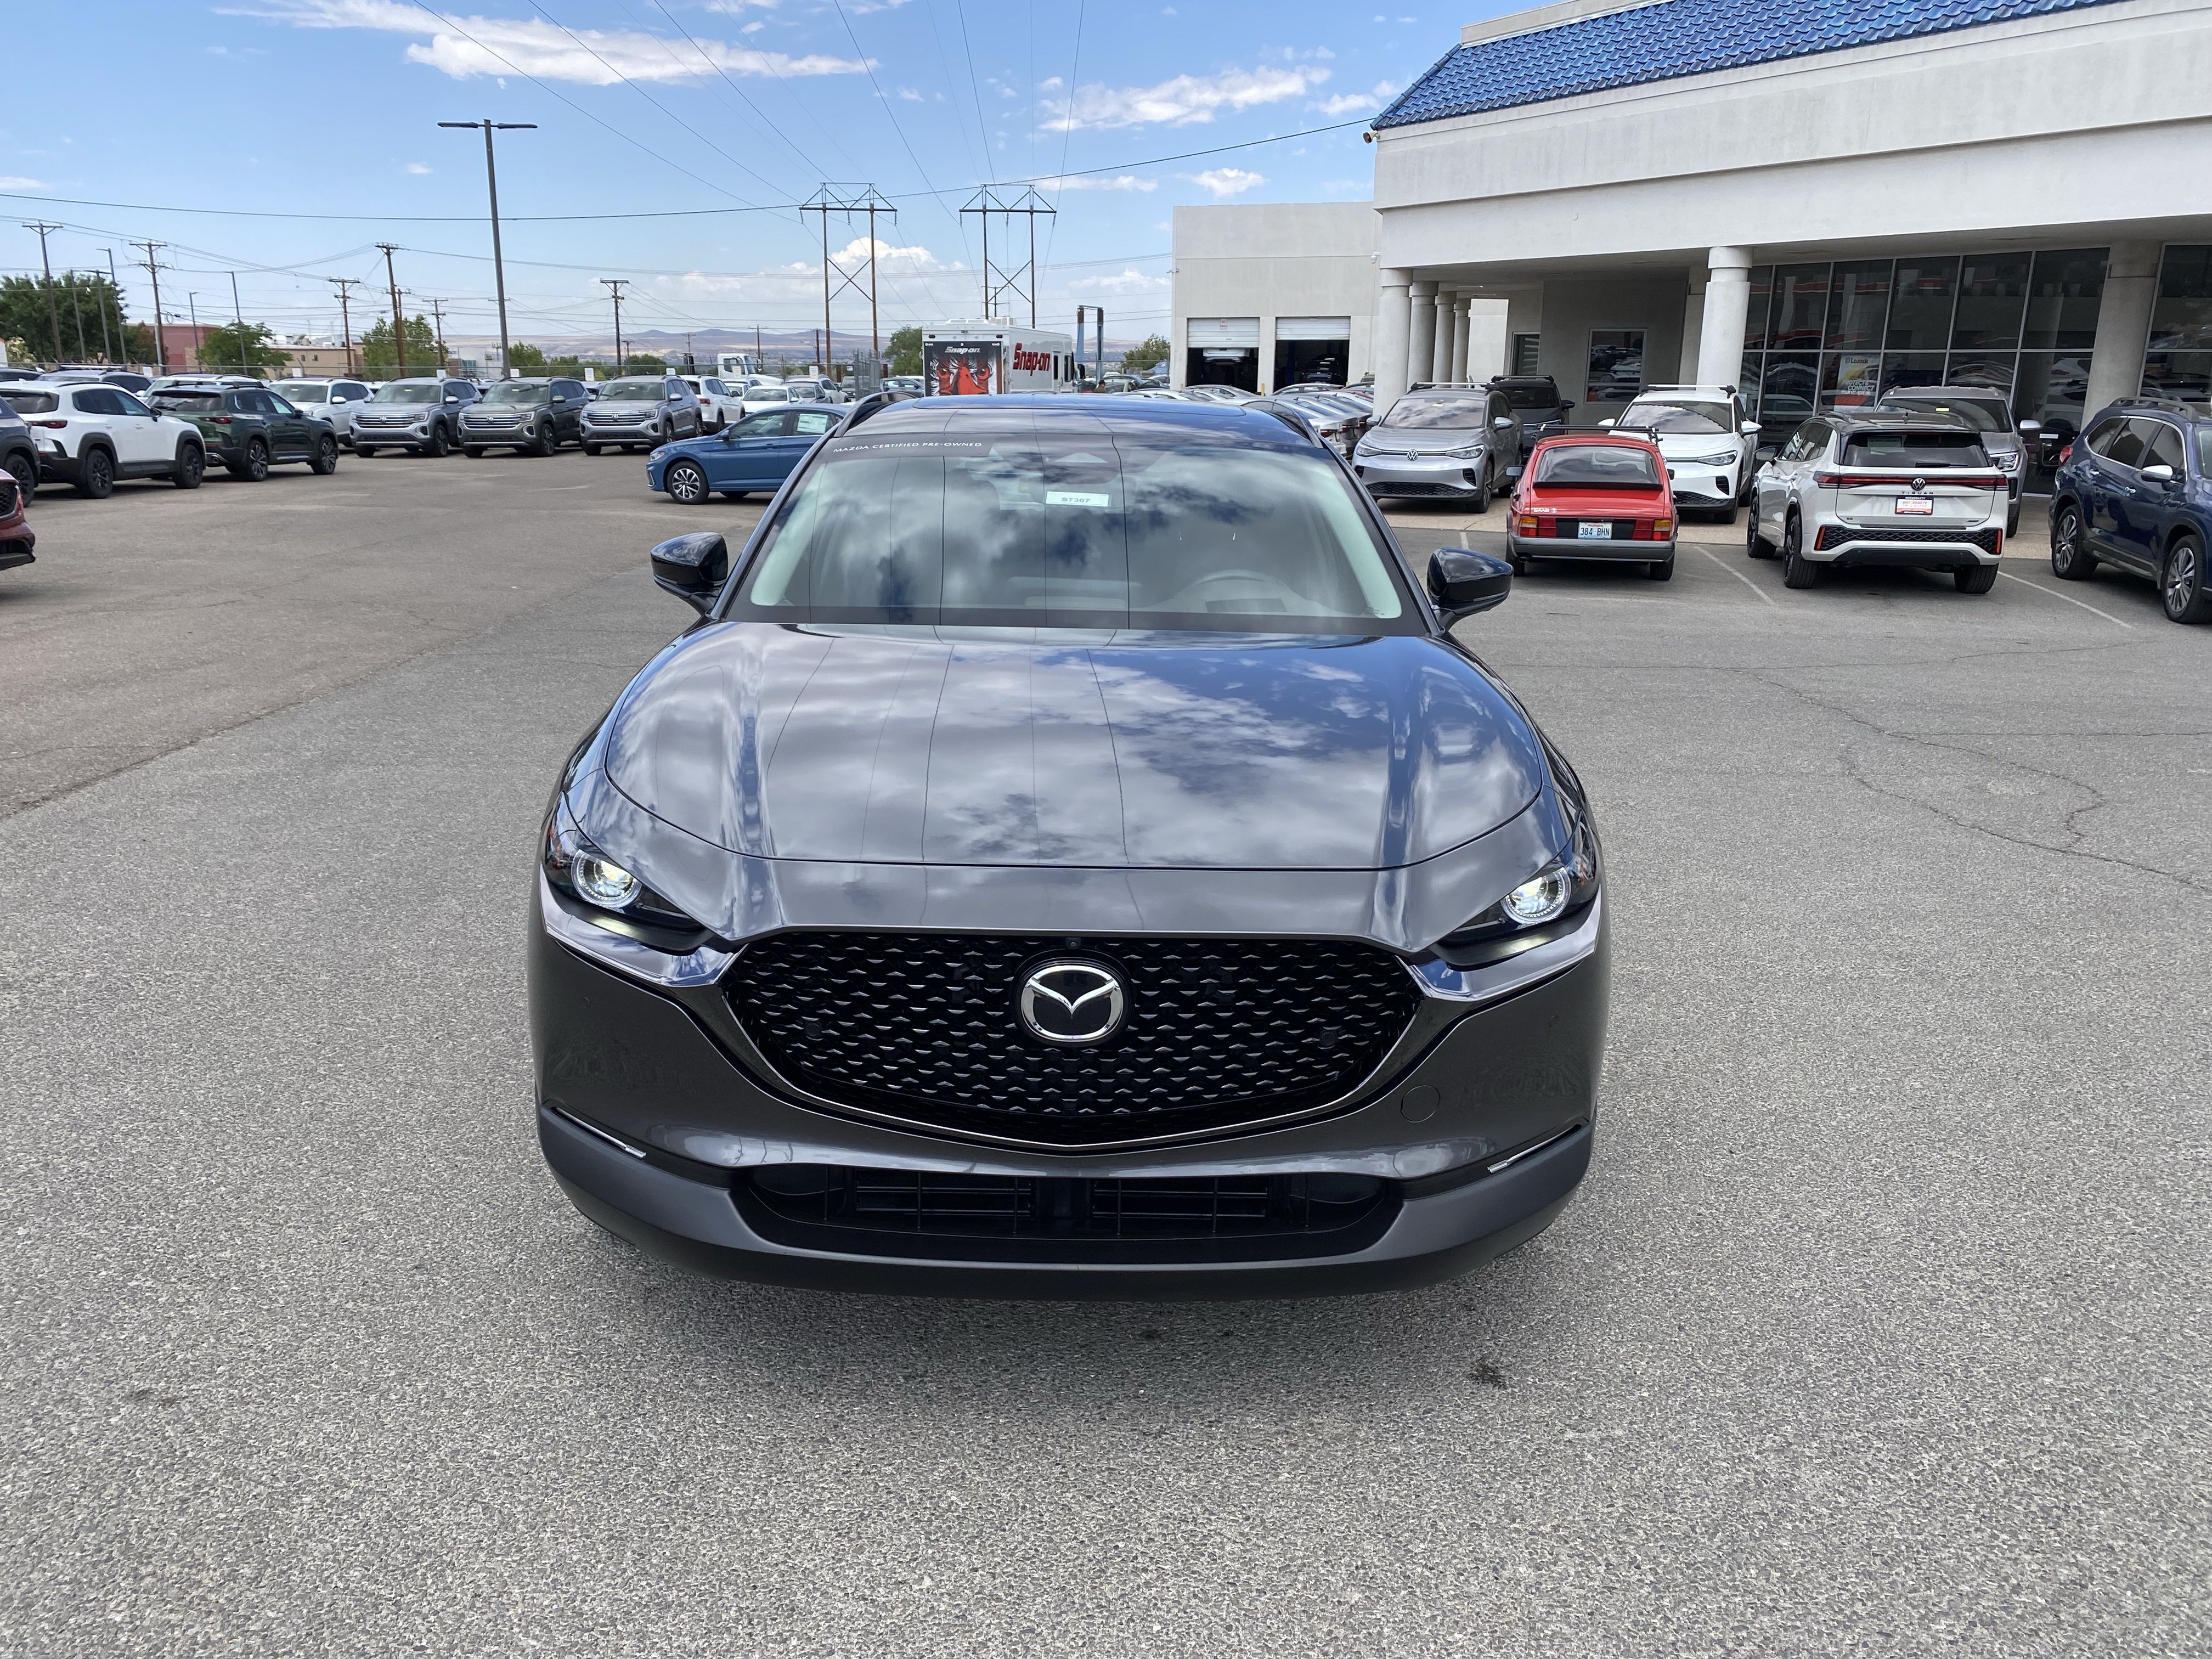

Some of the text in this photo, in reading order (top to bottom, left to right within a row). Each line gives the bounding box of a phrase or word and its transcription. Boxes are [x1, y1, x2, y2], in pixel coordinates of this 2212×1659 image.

[945, 346, 981, 354] Snap-on
[1013, 342, 1051, 376] Snap-on
[1580, 527, 1610, 536] 384 BHN
